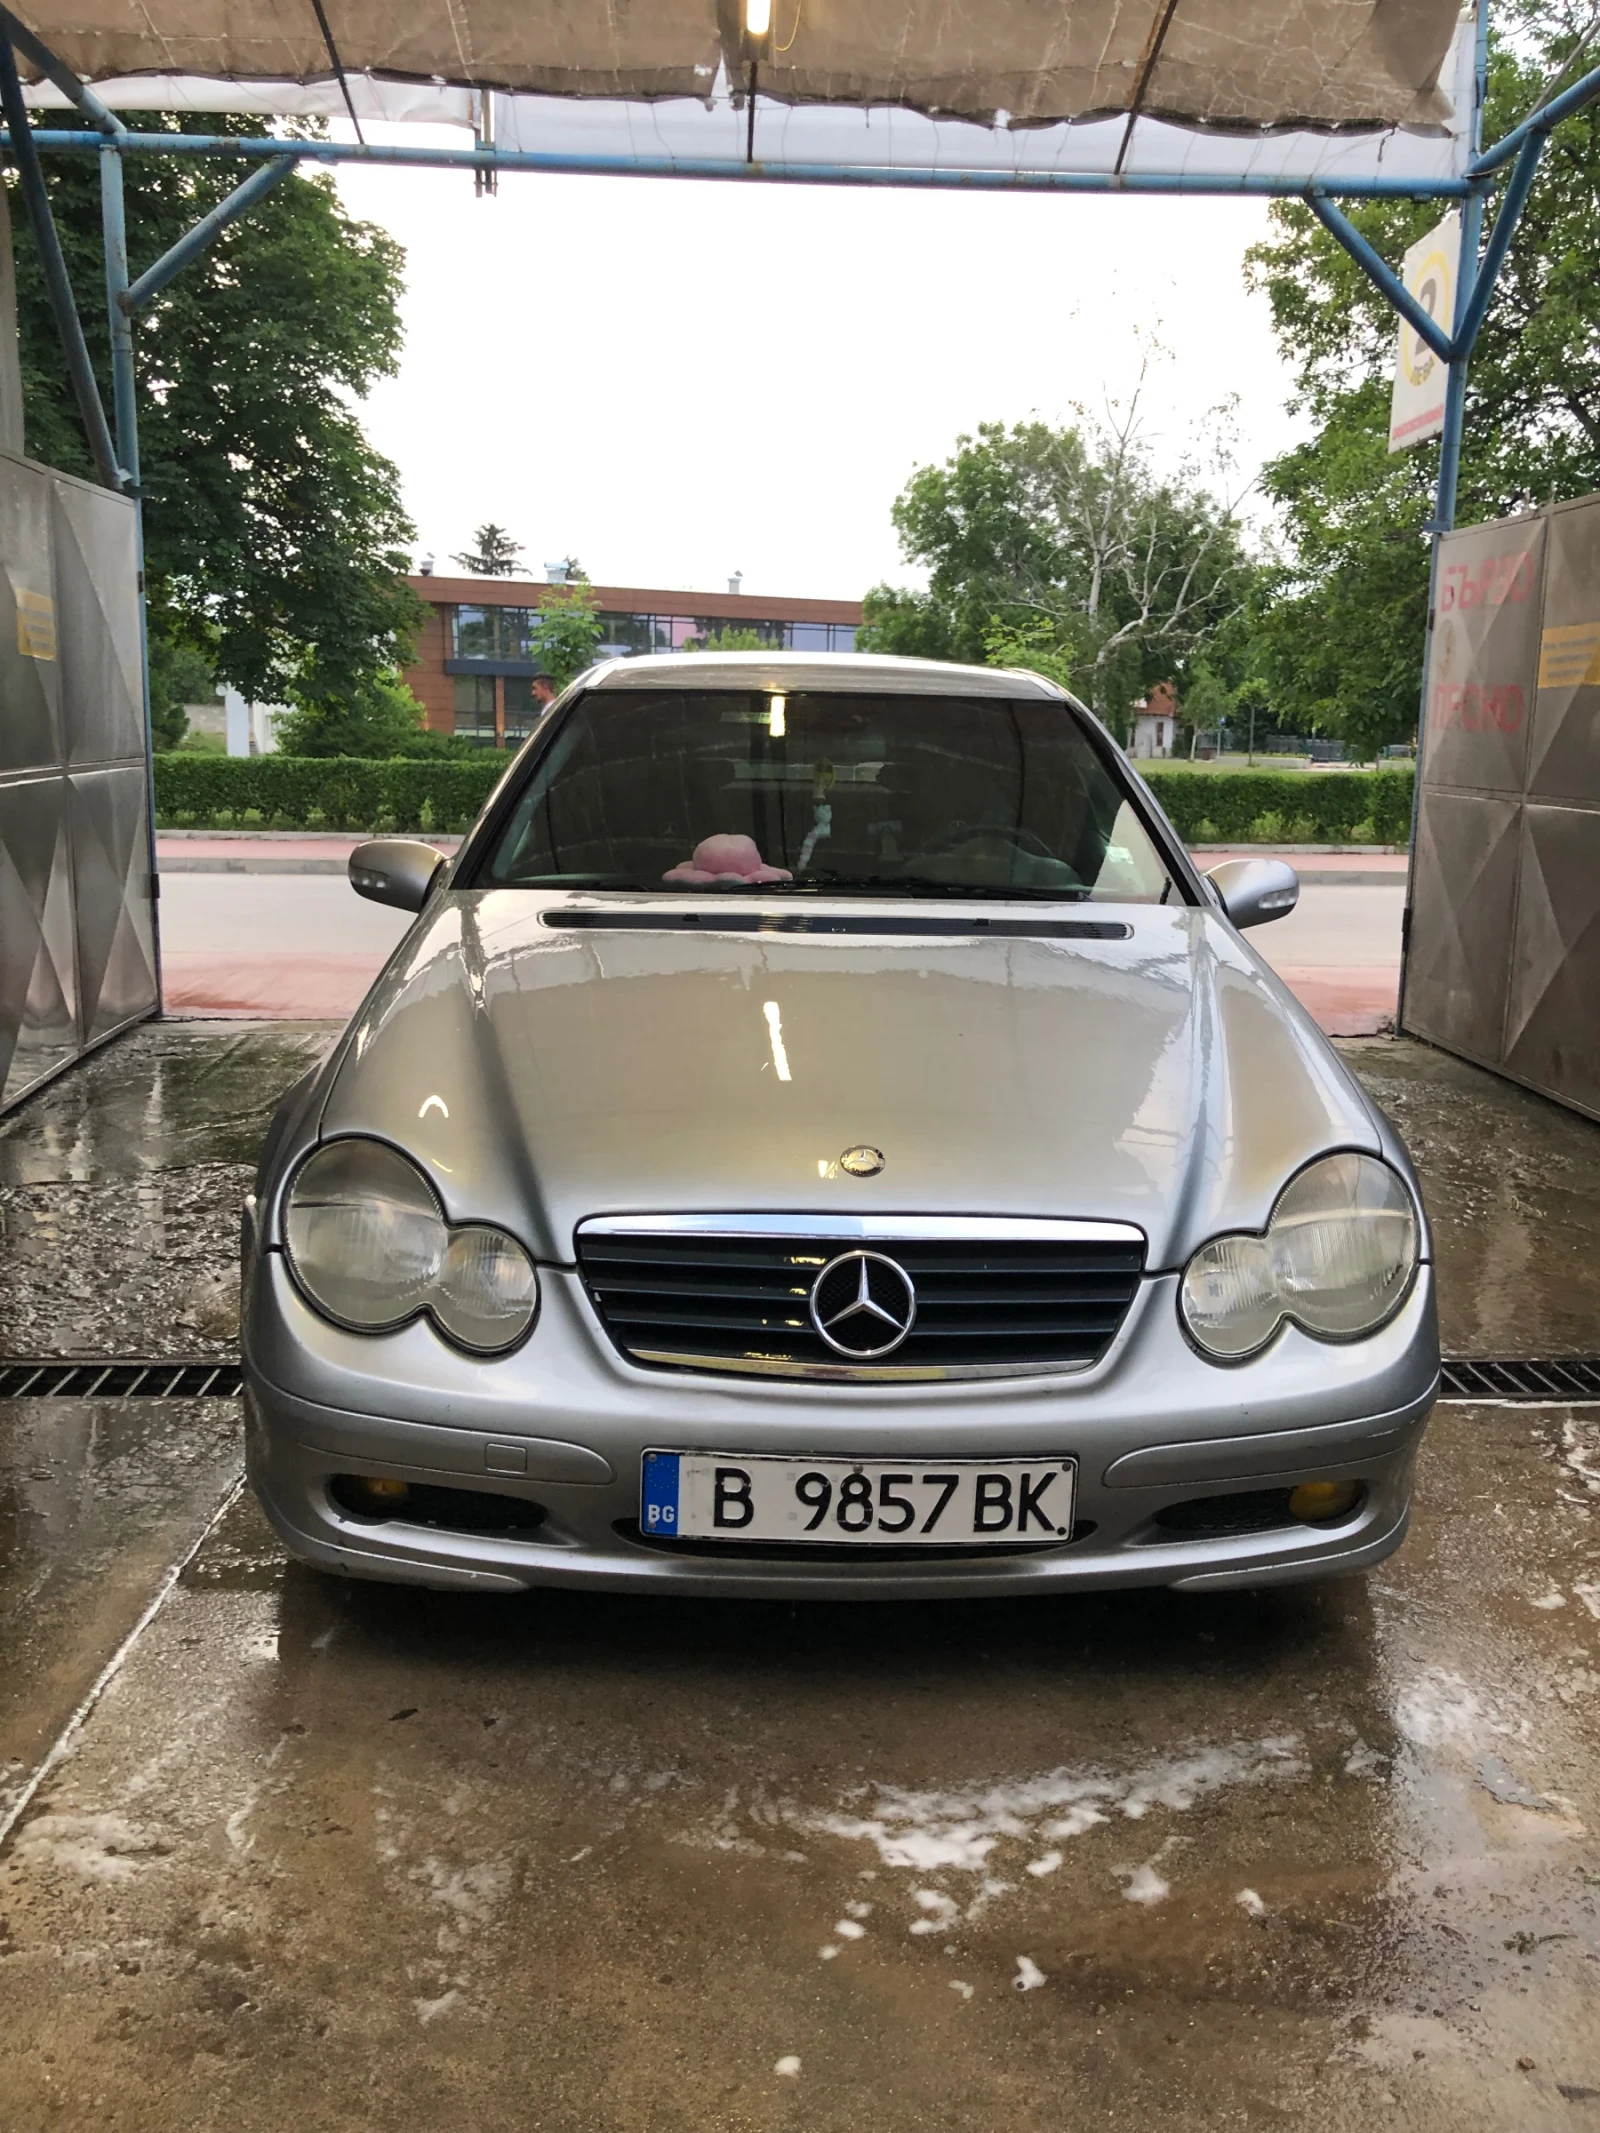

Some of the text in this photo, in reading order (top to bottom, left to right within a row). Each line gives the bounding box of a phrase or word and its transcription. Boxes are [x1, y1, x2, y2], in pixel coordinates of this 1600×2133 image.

[648, 1504, 675, 1523] BG
[713, 1467, 1059, 1534] B 9857 BK
